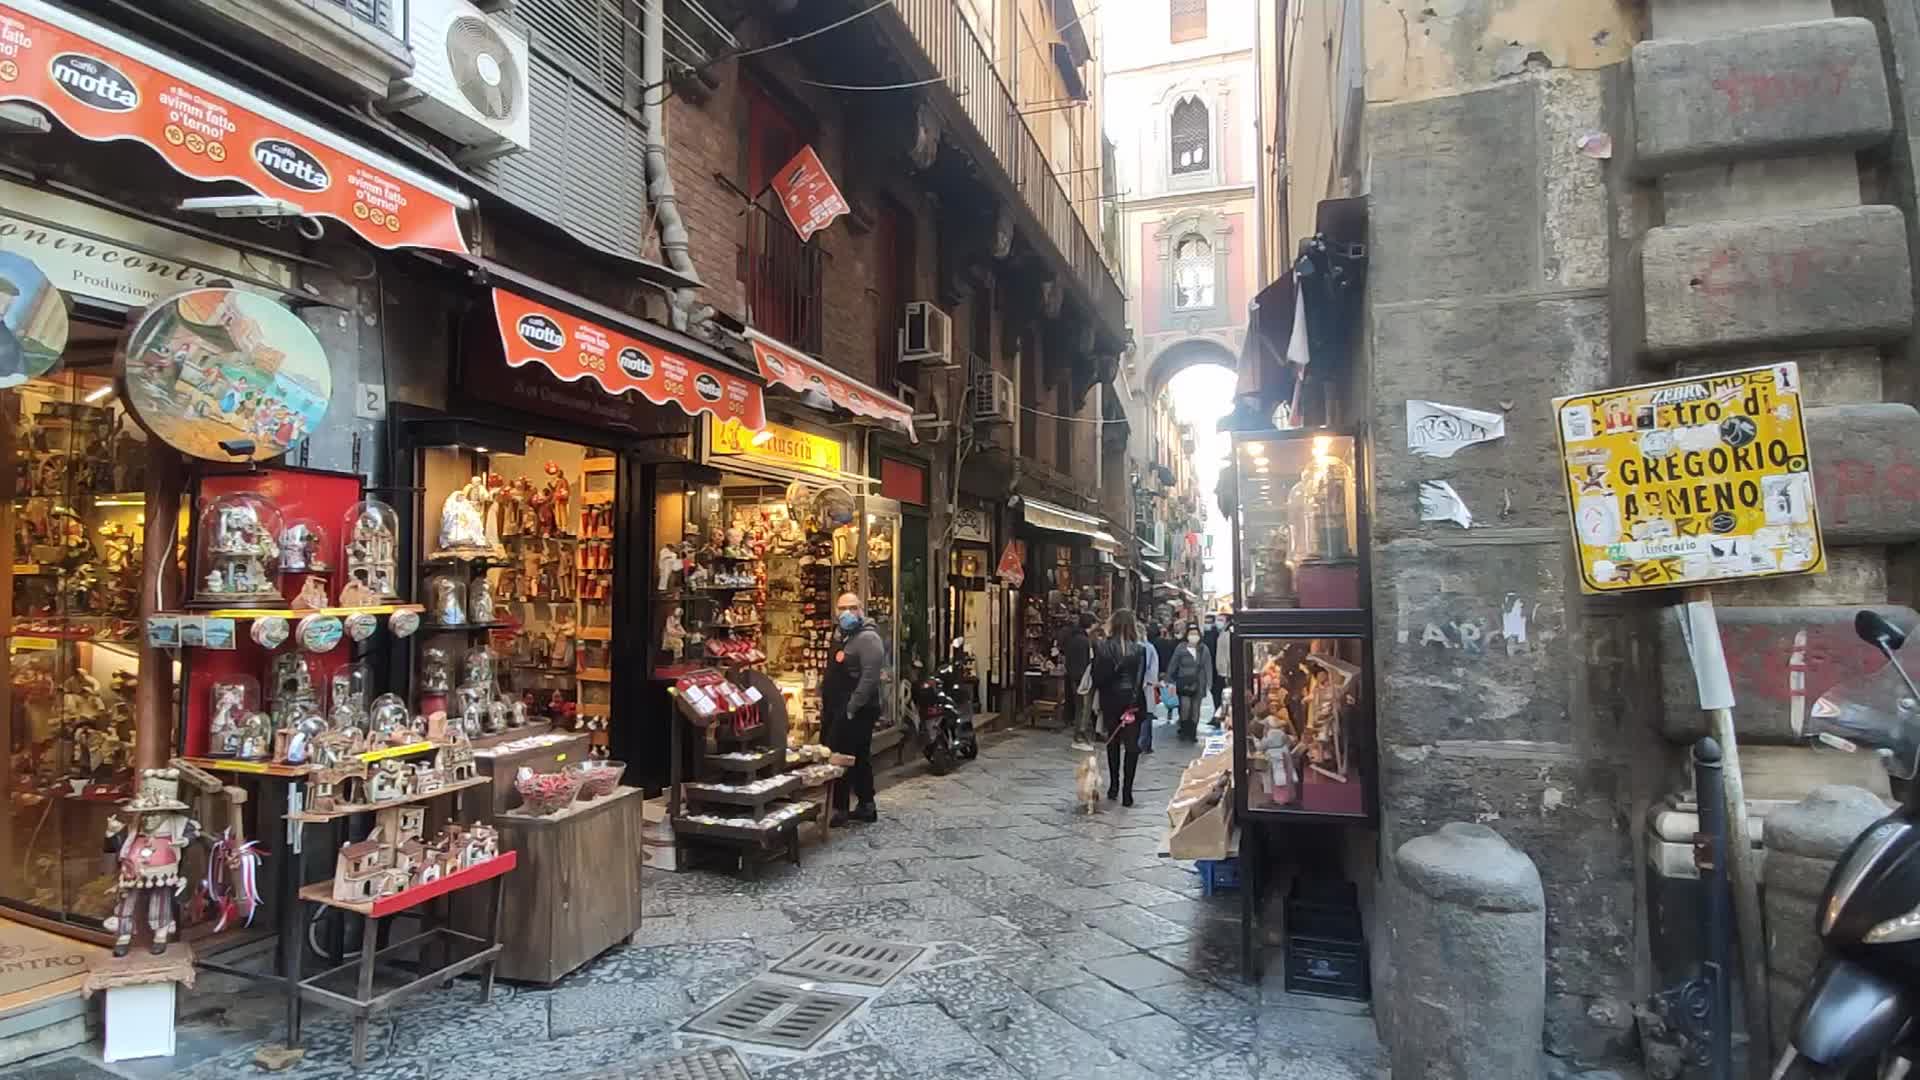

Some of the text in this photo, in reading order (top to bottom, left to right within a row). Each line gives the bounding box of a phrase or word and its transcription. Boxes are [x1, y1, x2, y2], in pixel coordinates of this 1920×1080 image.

[54, 63, 137, 107] motta
[160, 93, 236, 132] avimm fatto
[256, 148, 328, 187] motta
[520, 322, 563, 346] motta
[620, 355, 652, 375] motta
[695, 381, 722, 398] motta
[1619, 439, 1788, 486] GREGORIO
